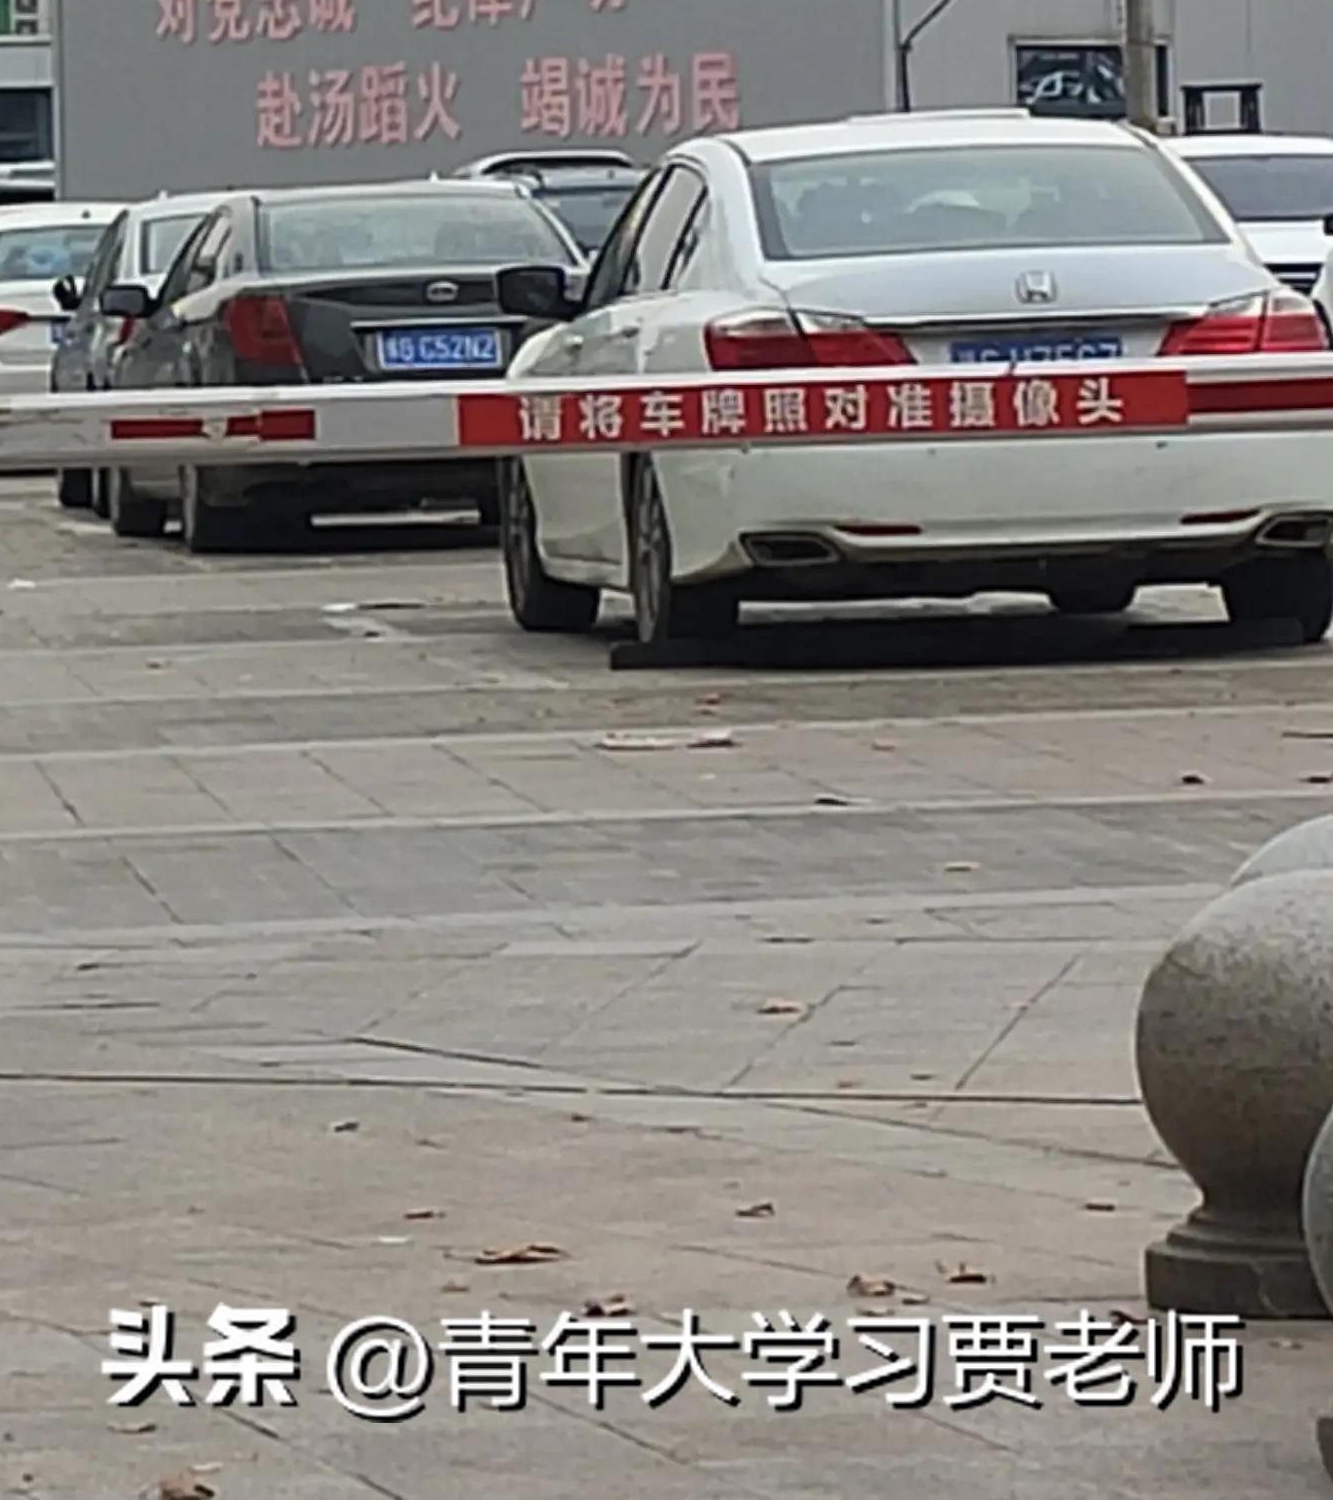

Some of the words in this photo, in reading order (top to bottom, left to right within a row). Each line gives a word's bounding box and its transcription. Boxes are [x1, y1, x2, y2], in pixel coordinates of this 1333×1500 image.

[255, 61, 461, 148] 赴汤蹈火
[519, 51, 743, 138] 竭诚为民
[517, 378, 1125, 442] 请将车牌照对准摄像头
